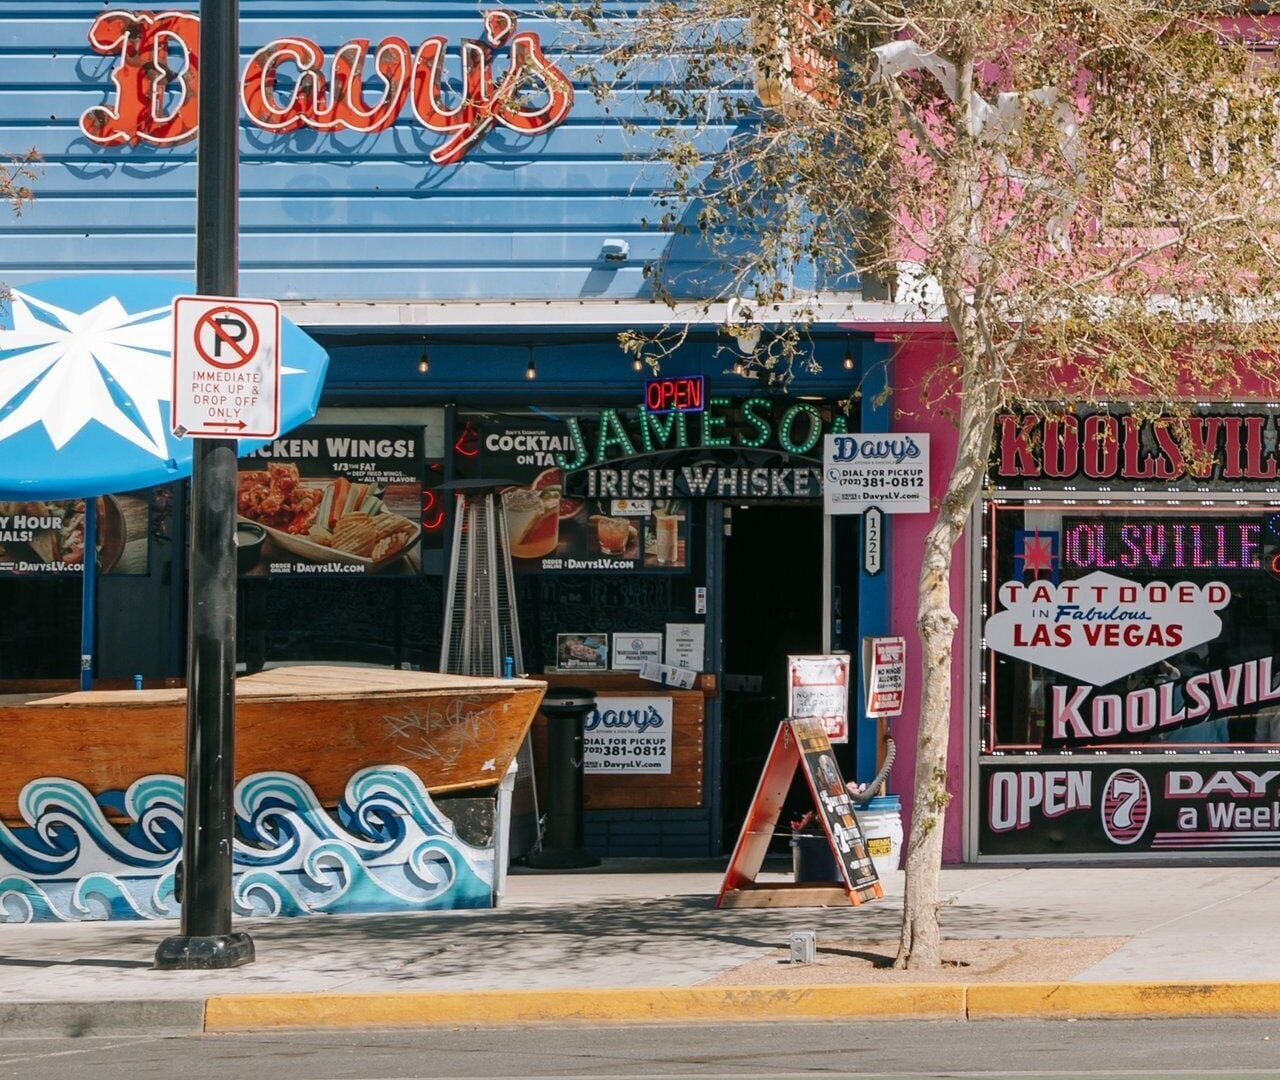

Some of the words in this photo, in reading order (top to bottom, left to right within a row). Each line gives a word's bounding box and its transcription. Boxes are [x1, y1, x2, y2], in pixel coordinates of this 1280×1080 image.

[79, 10, 574, 165] Davy's
[192, 371, 261, 383] IMMEDIATE
[192, 383, 220, 394] PICK
[228, 385, 244, 395] UP
[252, 385, 260, 395] &
[647, 379, 702, 410] OPEN
[194, 395, 227, 406] DROP
[235, 397, 258, 407] OFF
[208, 408, 241, 418] ONLY
[244, 439, 319, 459] CKEN
[326, 437, 415, 459] WINGS!
[486, 434, 577, 452] COCKTAIL
[832, 436, 921, 464] Davy's
[333, 463, 349, 472] 1/3
[360, 463, 376, 471] FAT
[517, 455, 534, 465] ON
[535, 451, 555, 467] TA
[842, 469, 864, 477] DIAL
[867, 469, 885, 477] FOR
[888, 469, 923, 477] PICKUP
[588, 468, 674, 497] IRISH
[840, 478, 861, 486] (702)
[862, 477, 924, 488] 381-0812
[863, 492, 920, 501] DavysLV.com
[14, 515, 62, 530] HOUR
[869, 517, 877, 566] 1221
[1066, 523, 1261, 569] OLSVILLE
[1005, 585, 1227, 604] TATTOOED
[1032, 609, 1049, 620] IN
[1055, 604, 1153, 623] Fabulous
[1013, 624, 1072, 647] LAS
[1087, 623, 1184, 647] VEGAS
[584, 738, 605, 746] DIAL
[609, 738, 627, 746] FOR
[630, 738, 666, 746] PICKUP
[603, 746, 666, 756] 381-0812
[604, 760, 661, 770] DavysLV.com
[989, 768, 1093, 832] OPEN
[1110, 775, 1143, 831] 7
[1178, 805, 1199, 830] a
